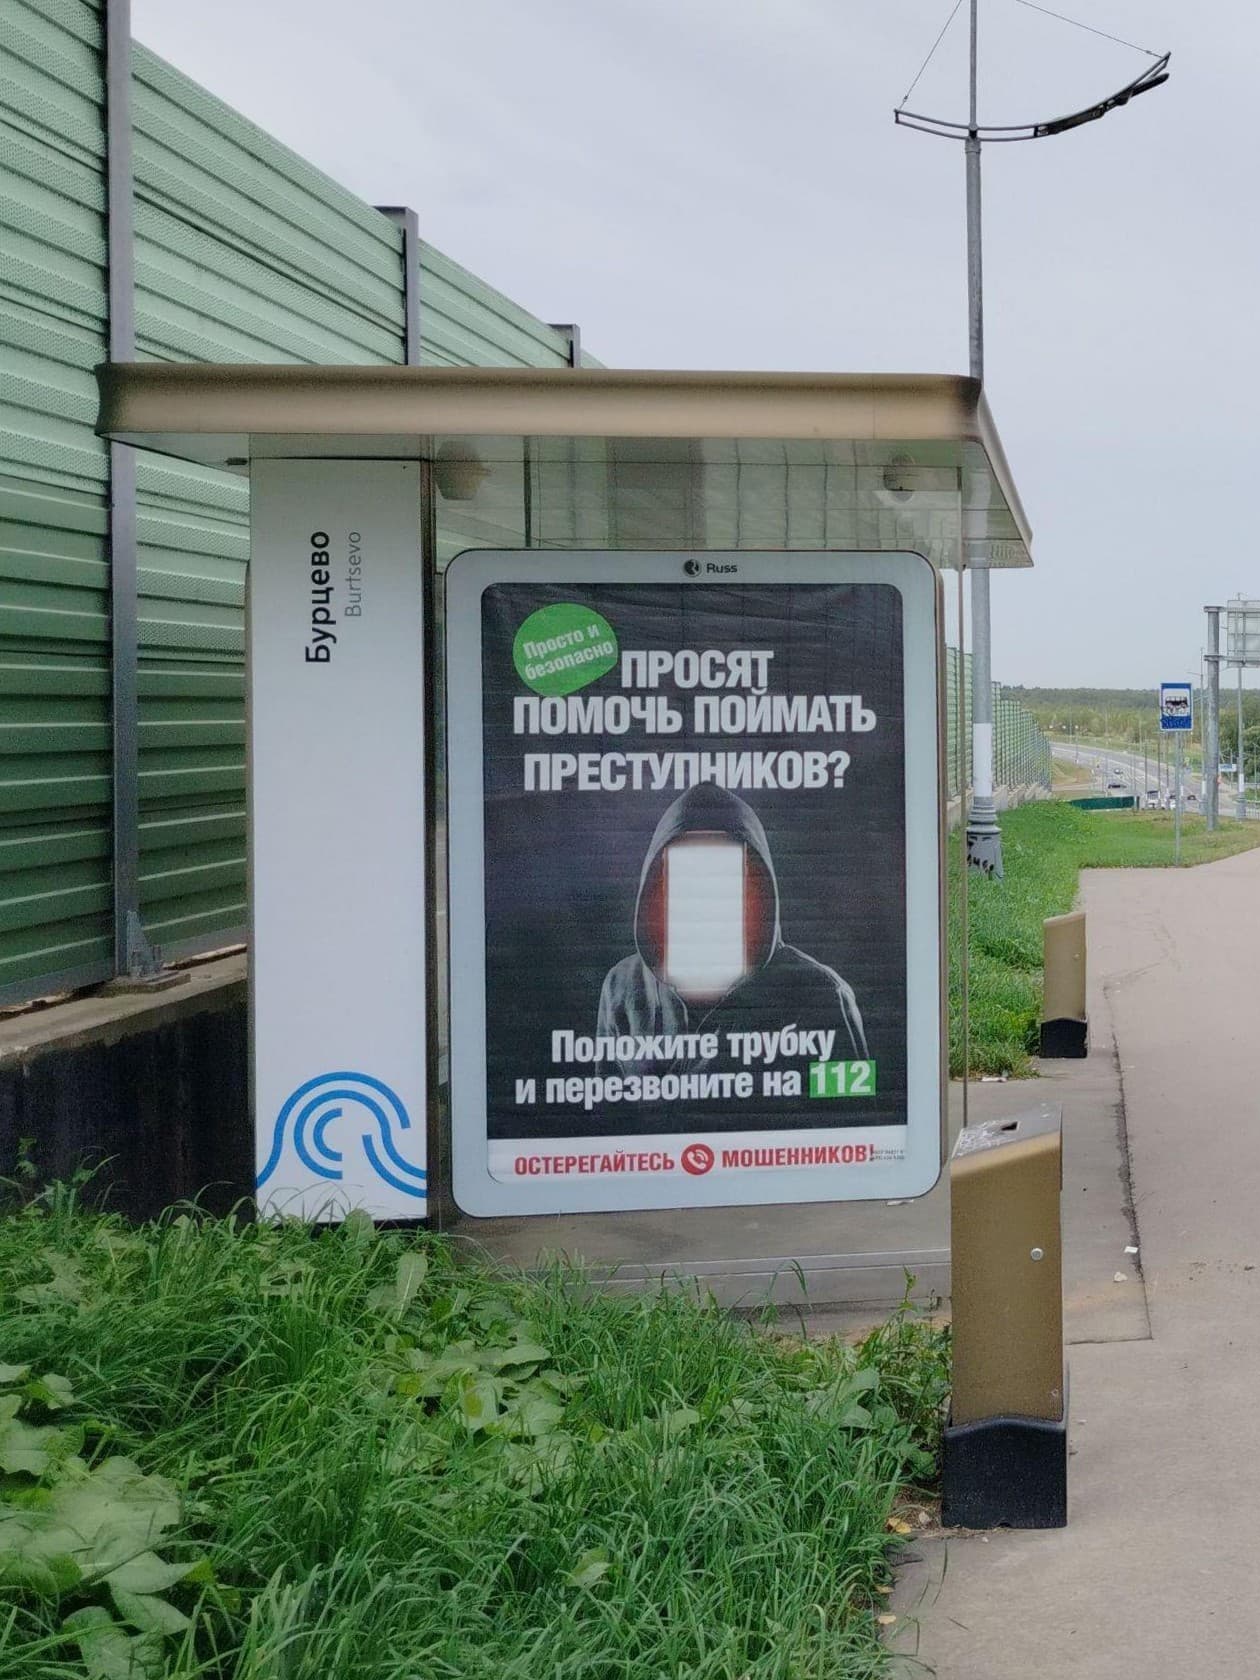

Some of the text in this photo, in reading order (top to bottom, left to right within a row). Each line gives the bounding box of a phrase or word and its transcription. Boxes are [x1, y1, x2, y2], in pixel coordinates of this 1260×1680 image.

[344, 531, 362, 617] Burtsevo
[706, 562, 738, 573] Russ
[305, 531, 336, 662] Бурцево
[523, 624, 600, 659] Просто и
[525, 641, 614, 681] безопасно
[621, 650, 775, 688] ПРОСЯТ
[513, 686, 877, 735] ПОМОЧЬ ПОЙМАТЬ
[524, 751, 850, 791] ПРЕСТУПНИКОВ?
[551, 1024, 836, 1065] Положите трубку
[515, 1064, 872, 1110] и перезвоните на 112
[514, 1149, 675, 1176] ОСТЕРЕГАЙТЕСЬ
[721, 1143, 875, 1168] МОШЕННИКОВ!
